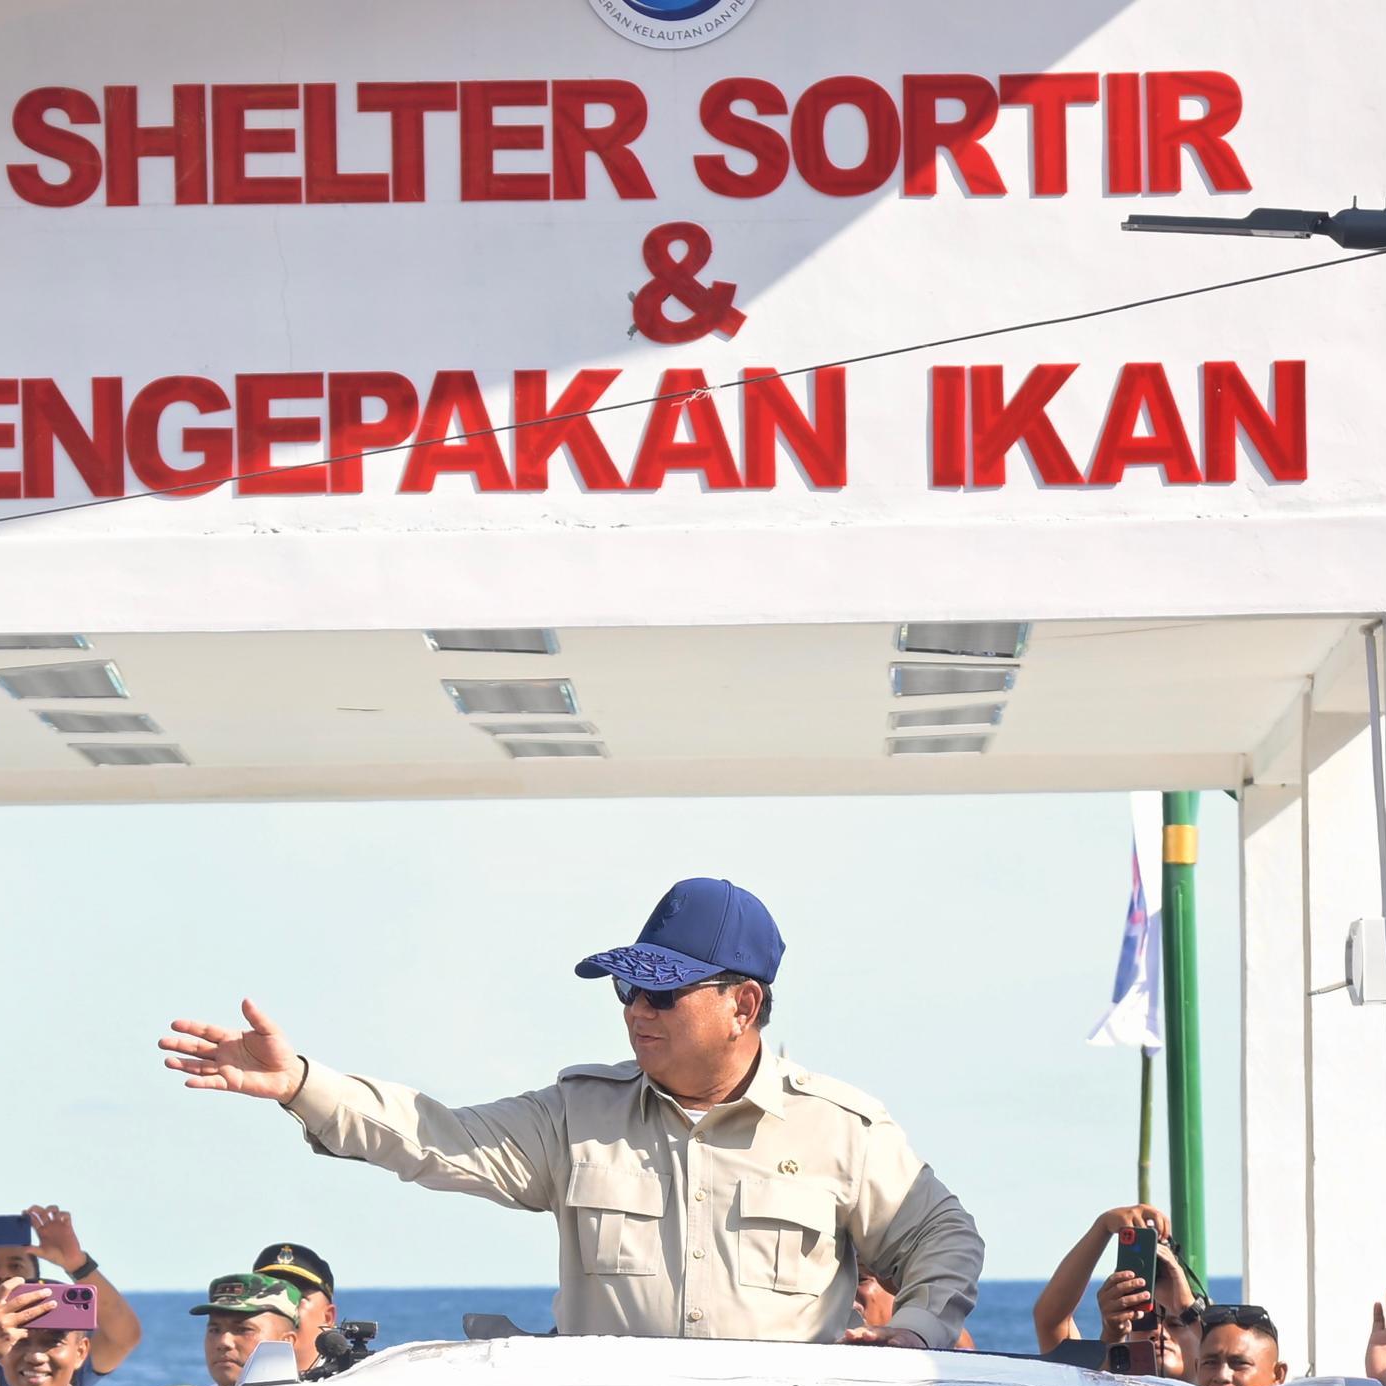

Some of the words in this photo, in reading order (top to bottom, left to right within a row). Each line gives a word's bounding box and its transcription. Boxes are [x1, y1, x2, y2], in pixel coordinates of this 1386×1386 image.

[633, 23, 703, 41] KELAUTAN
[705, 10, 732, 32] DAN
[6, 79, 657, 208] SHELTER
[693, 69, 1254, 199] SORTIR
[632, 222, 748, 345] &
[931, 359, 1309, 489] IKAN
